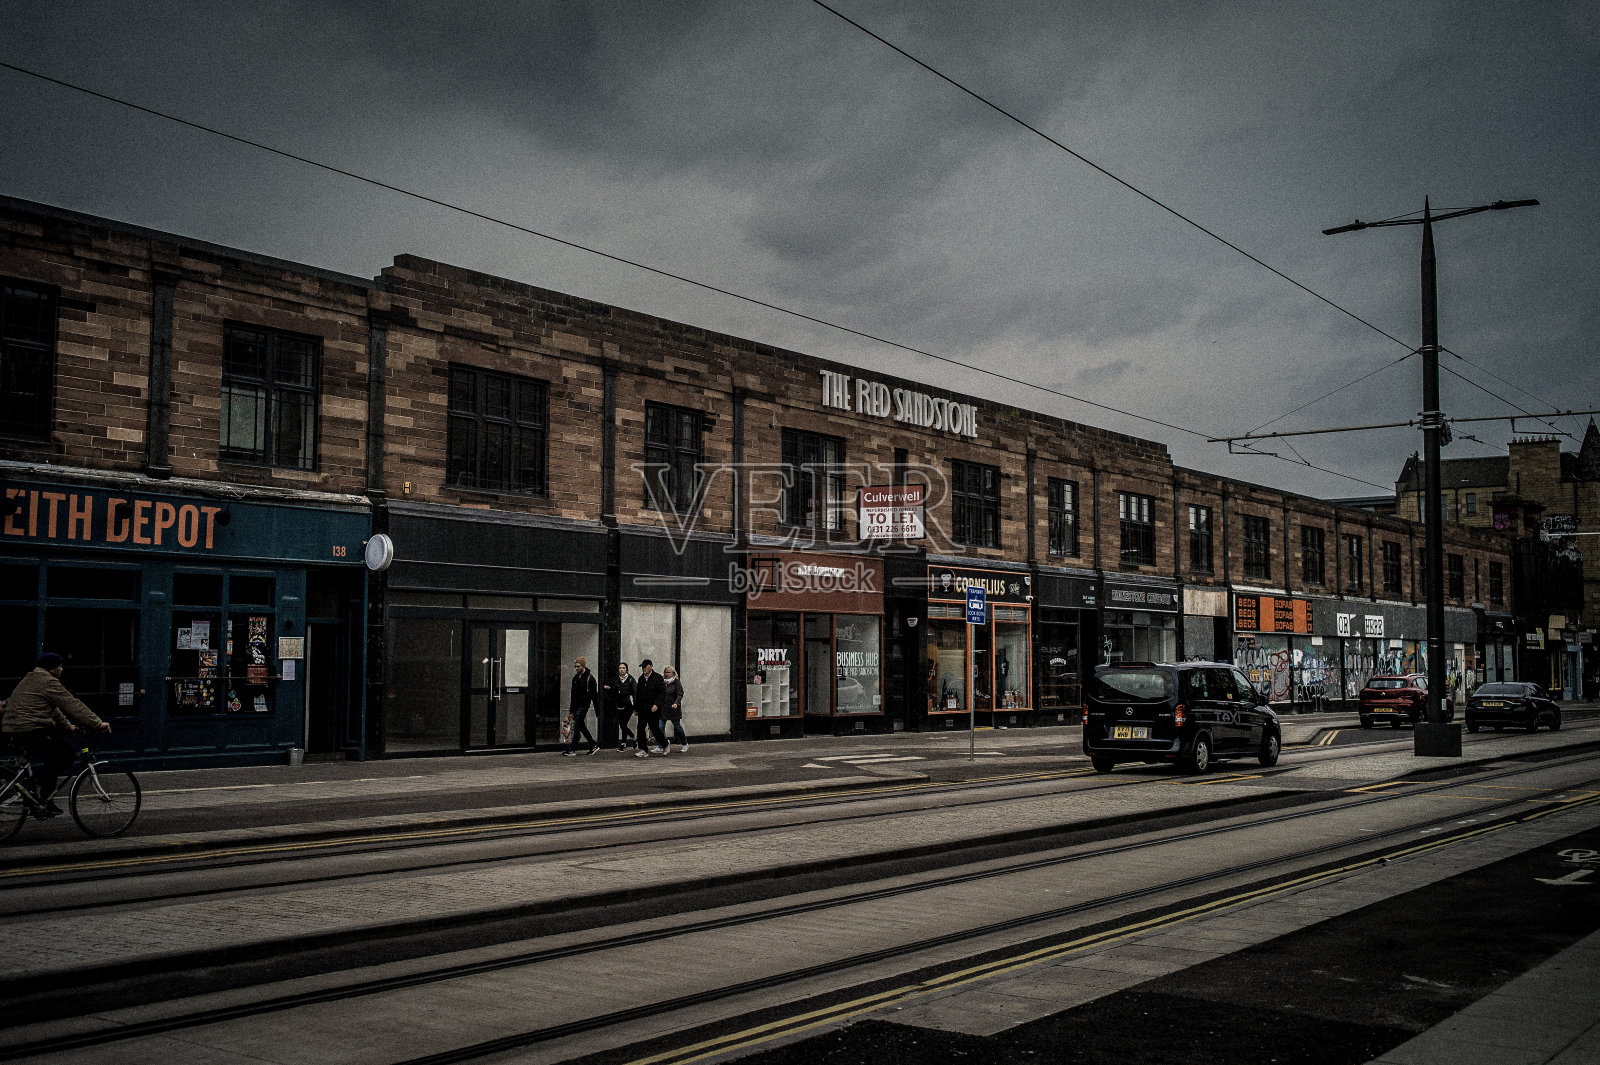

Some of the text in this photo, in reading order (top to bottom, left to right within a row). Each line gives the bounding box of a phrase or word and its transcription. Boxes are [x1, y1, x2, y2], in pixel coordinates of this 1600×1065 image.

[820, 369, 978, 438] THE RED SANDSTONE
[863, 490, 920, 503] Culverwell
[106, 497, 222, 549] DEPOT
[868, 512, 916, 524] TO LET
[867, 524, 917, 533] 0131 226 6611
[332, 545, 346, 557] 138
[955, 576, 1006, 596] CORNELIUS
[1238, 597, 1256, 608] BEDS
[1274, 599, 1293, 609] SOFAS
[1238, 608, 1257, 618] BEDS
[1274, 610, 1293, 620] SOFAS
[1238, 619, 1257, 629] BEDS
[1275, 621, 1294, 631] SOFAS
[1338, 615, 1349, 634] OR
[757, 648, 788, 662] DIRTY
[836, 651, 879, 667] BUSINESS HUB
[1213, 710, 1241, 723] TAXI
